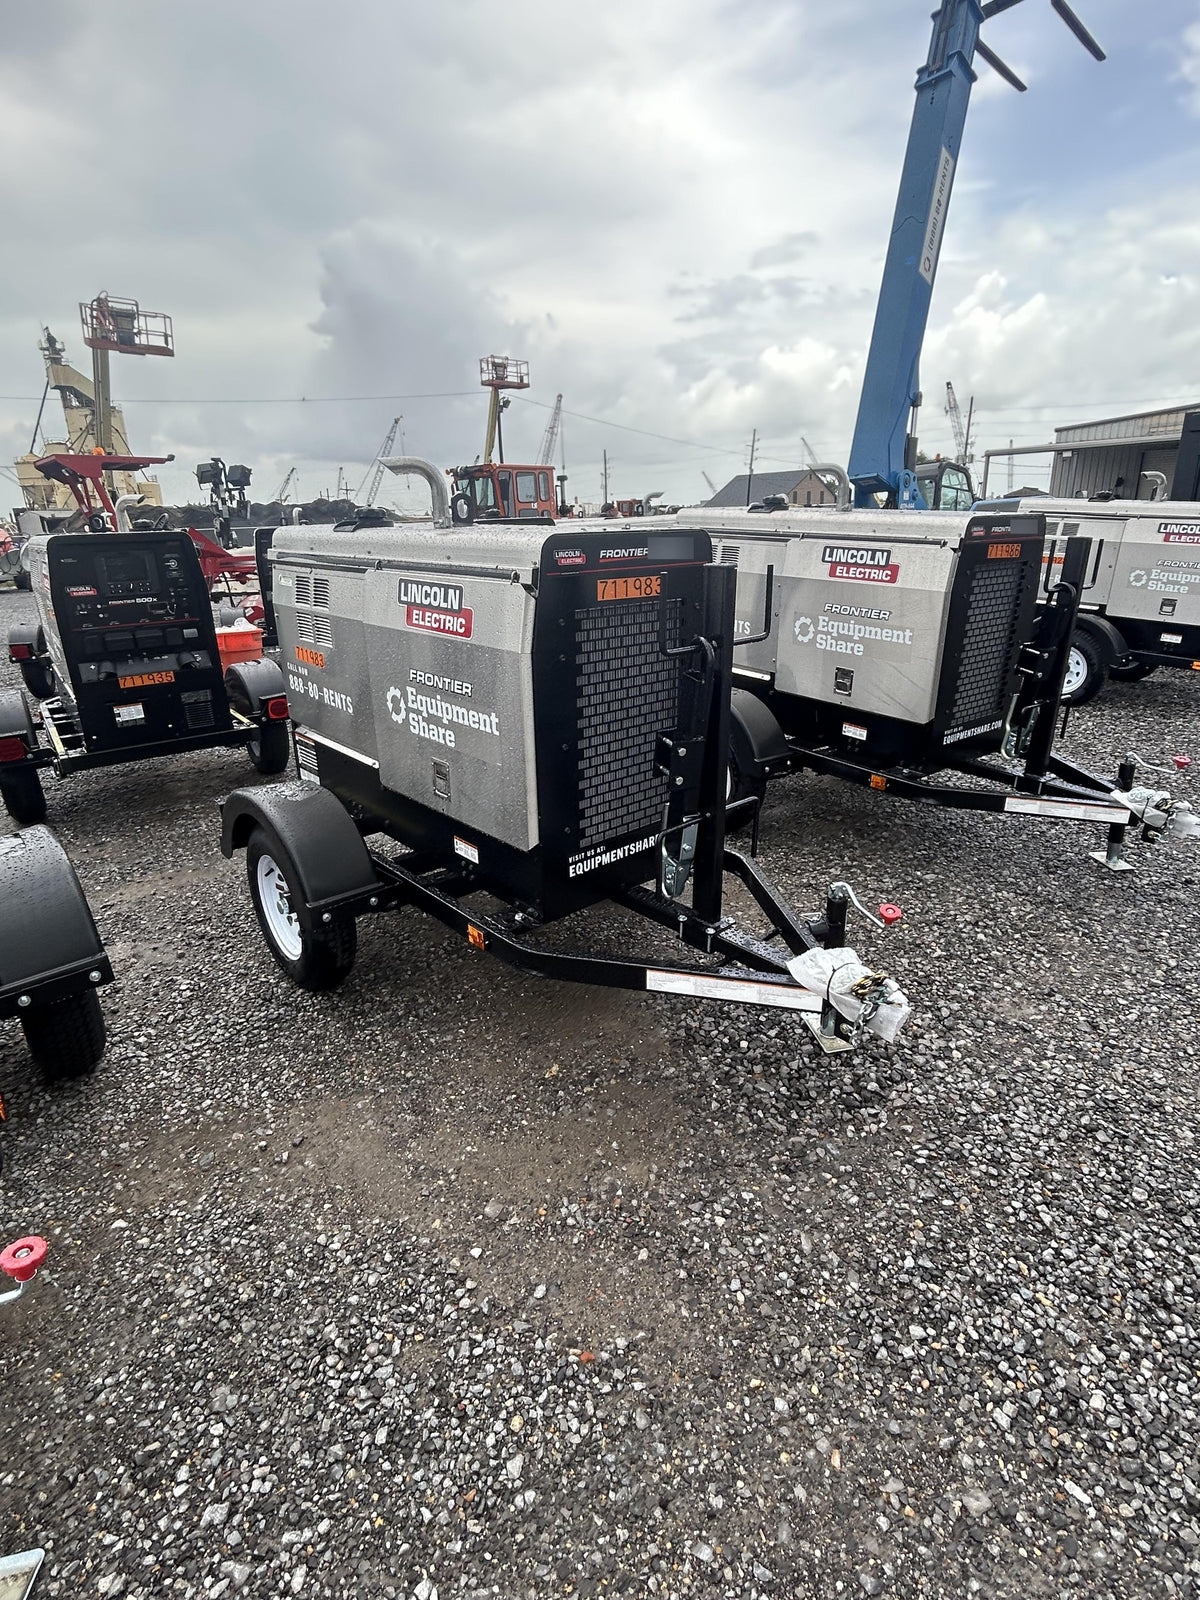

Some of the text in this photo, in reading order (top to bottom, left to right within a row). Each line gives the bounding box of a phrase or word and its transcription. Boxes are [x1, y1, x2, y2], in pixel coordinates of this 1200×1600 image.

[555, 550, 581, 558] LINCOLN
[824, 548, 888, 565] LINCOLN
[989, 545, 1020, 556] 711986
[835, 566, 892, 580] ELECTRIC
[400, 582, 459, 610] LINCOLN
[600, 577, 661, 599] 711983
[1147, 580, 1189, 594] Share
[412, 610, 466, 633] ELECTRIC
[824, 603, 890, 621] FRONTIER
[817, 616, 913, 644] Equipment
[816, 634, 864, 656] Share
[295, 645, 324, 668] 711983
[121, 672, 173, 687] 711935
[409, 669, 473, 697] FRONTIER
[289, 674, 354, 714] 888-80-RENTS
[406, 686, 500, 736] Equipment
[409, 712, 456, 748] Share
[943, 719, 1003, 745] EQUIPMENTSHARE.COM
[568, 852, 585, 863] VISIT
[586, 849, 595, 857] US
